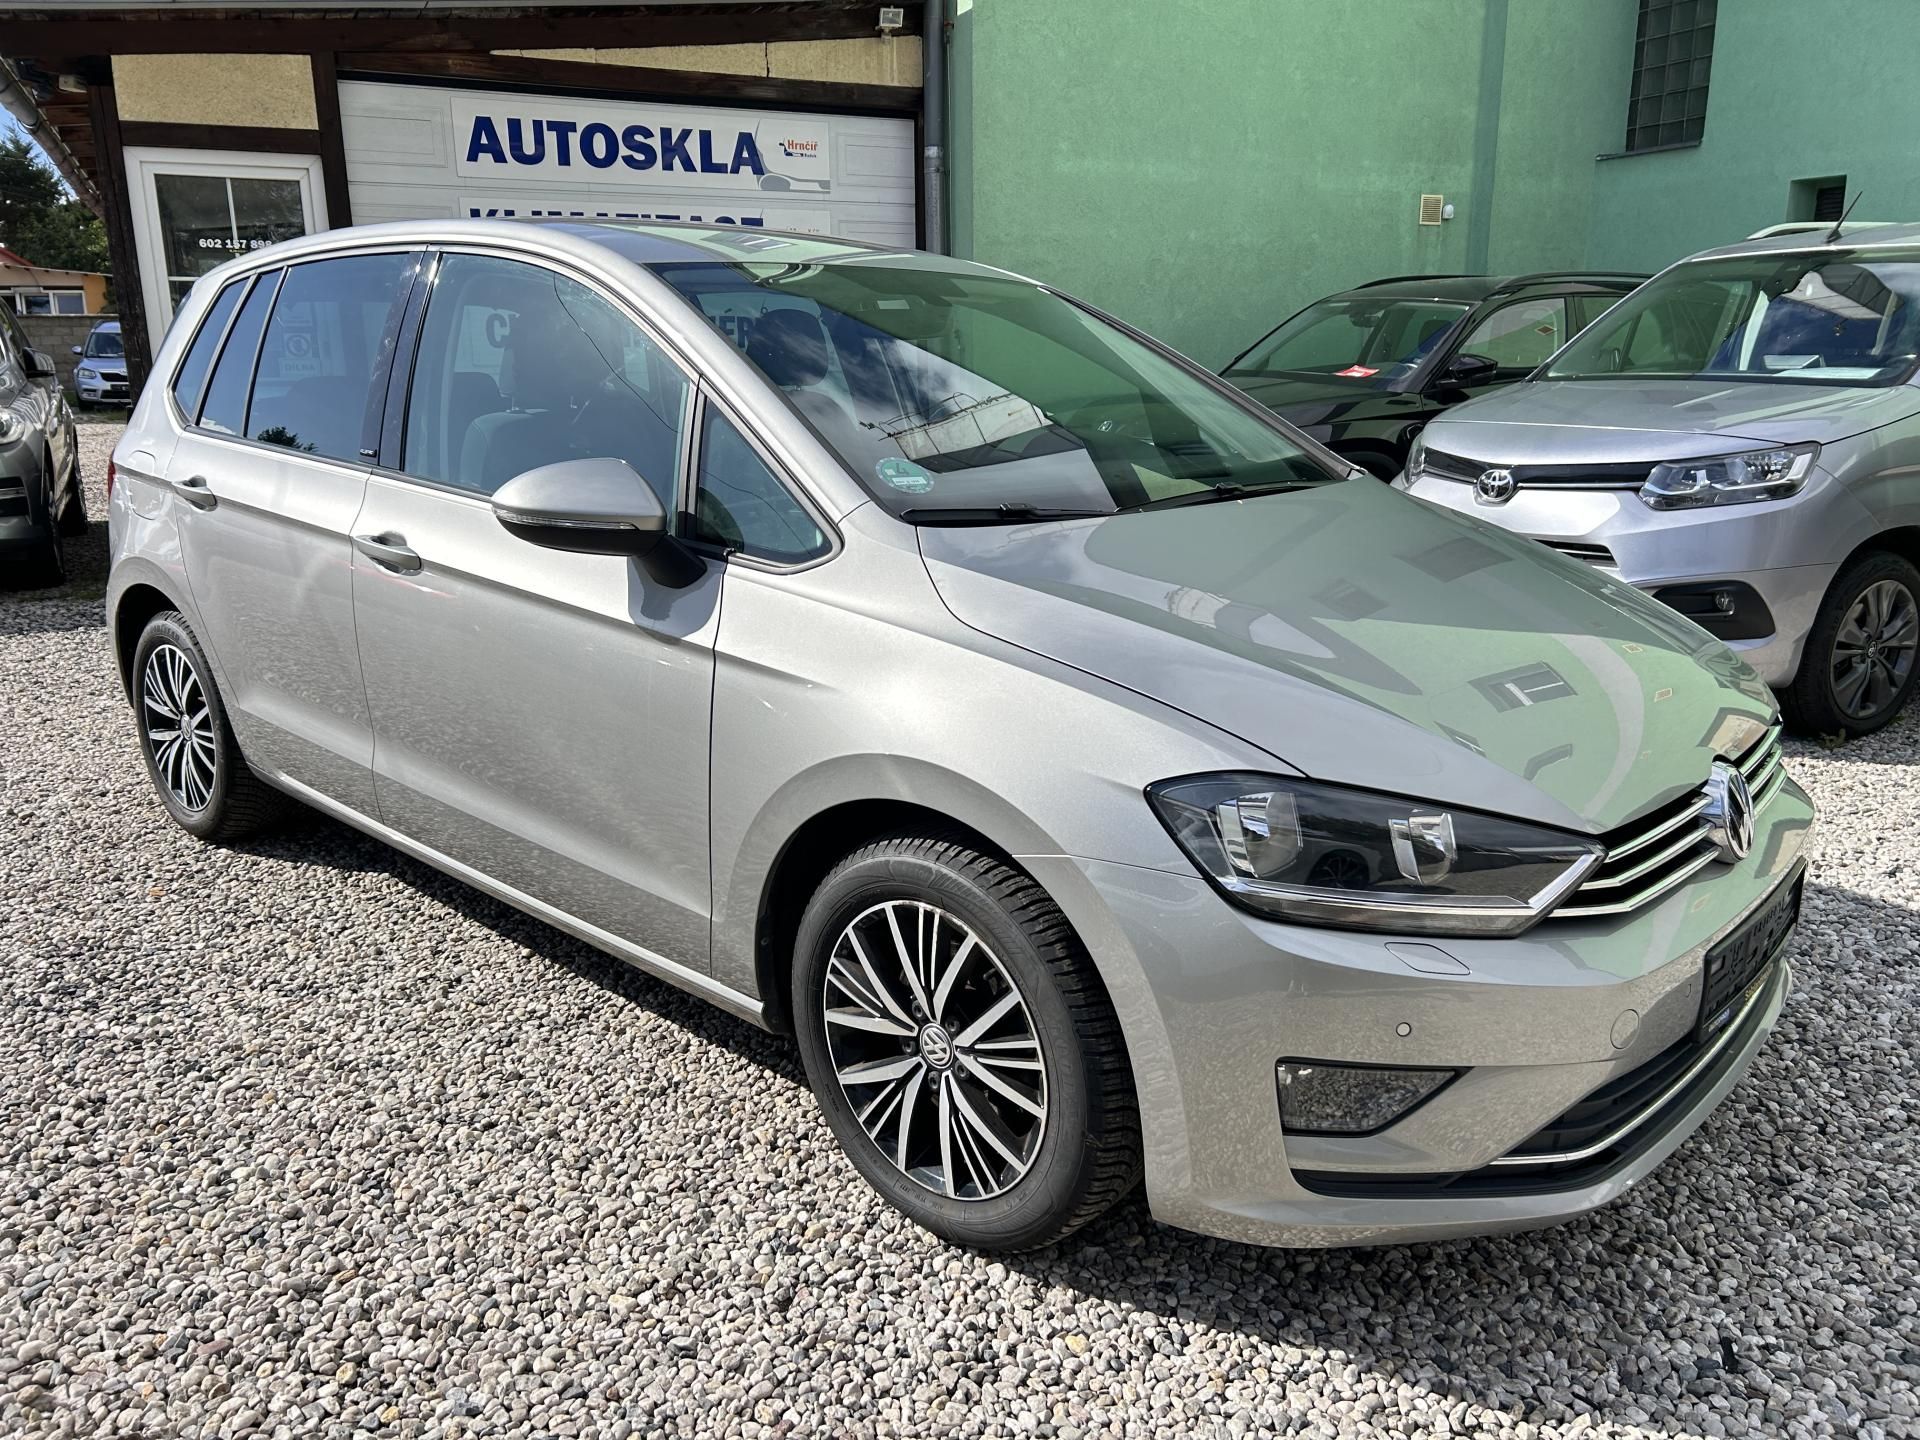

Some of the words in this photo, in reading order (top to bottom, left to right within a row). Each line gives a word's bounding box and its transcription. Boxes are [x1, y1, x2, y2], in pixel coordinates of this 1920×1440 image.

[466, 115, 765, 176] AUTOSKLA
[198, 238, 223, 249] 602
[225, 239, 247, 249] 157
